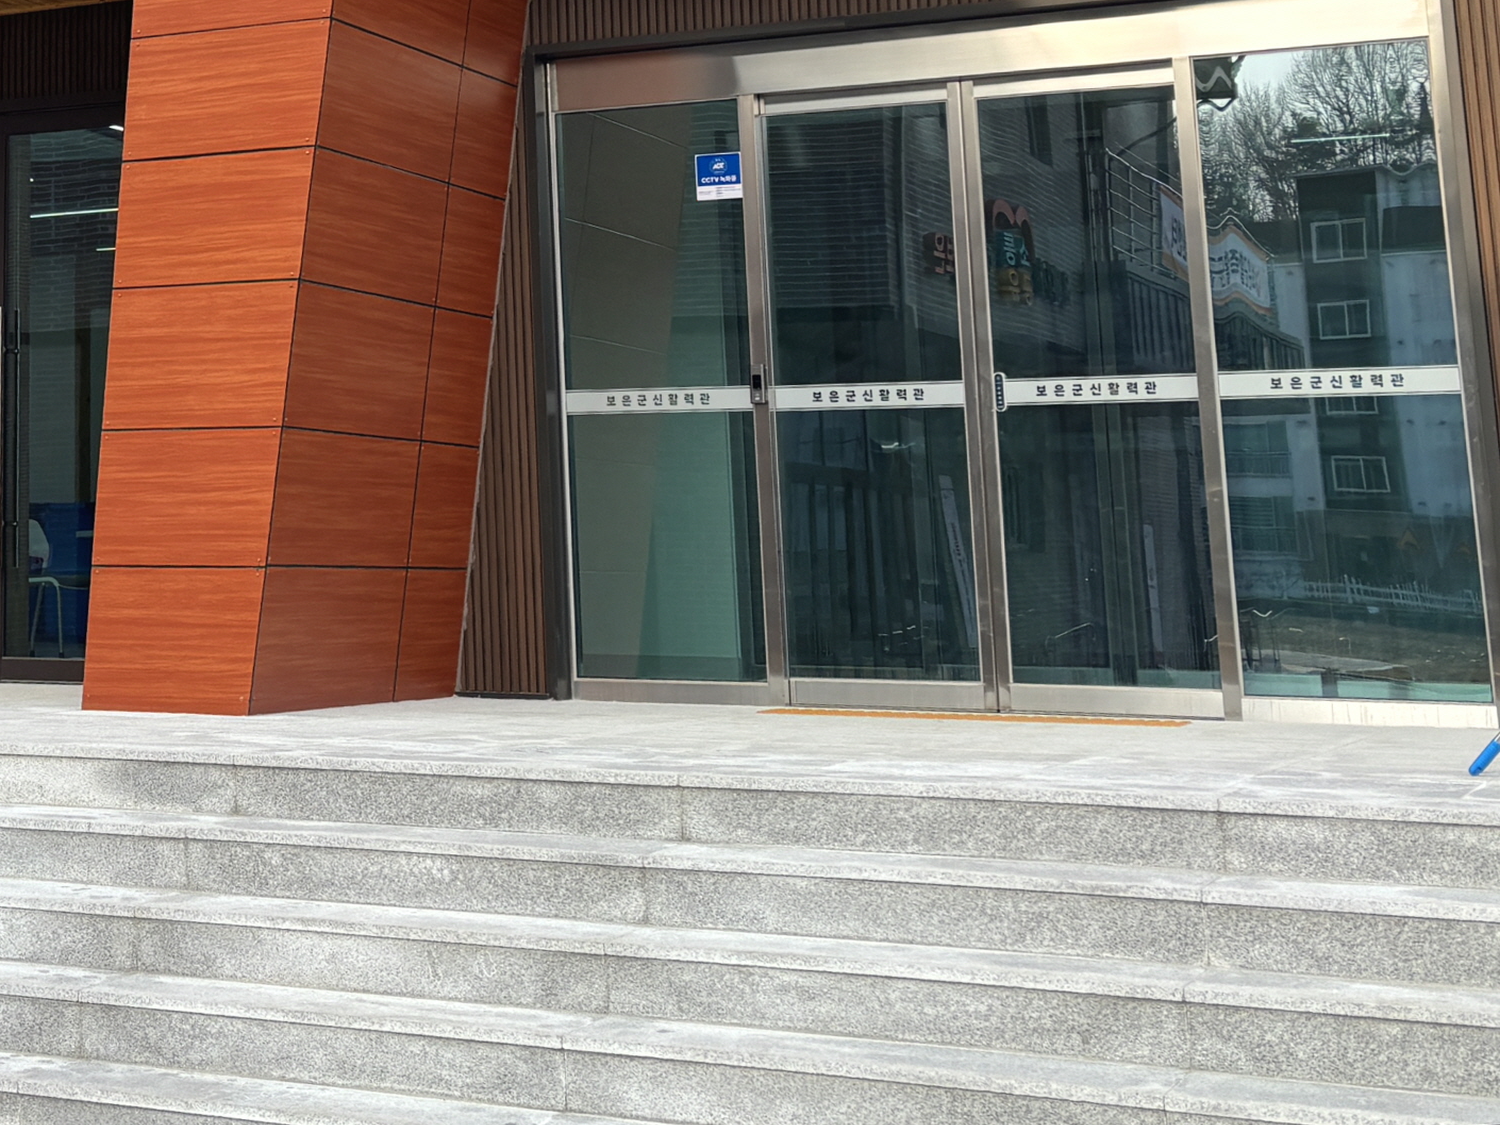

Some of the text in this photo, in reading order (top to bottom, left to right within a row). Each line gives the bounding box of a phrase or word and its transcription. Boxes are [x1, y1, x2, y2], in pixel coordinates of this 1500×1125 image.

[701, 176, 719, 184] CCTV
[1035, 380, 1157, 397] 보은군신활력관
[1269, 373, 1404, 390] 보은군신활력관
[606, 392, 710, 407] 보은군신활력관
[812, 387, 925, 403] 보은군신활력관
